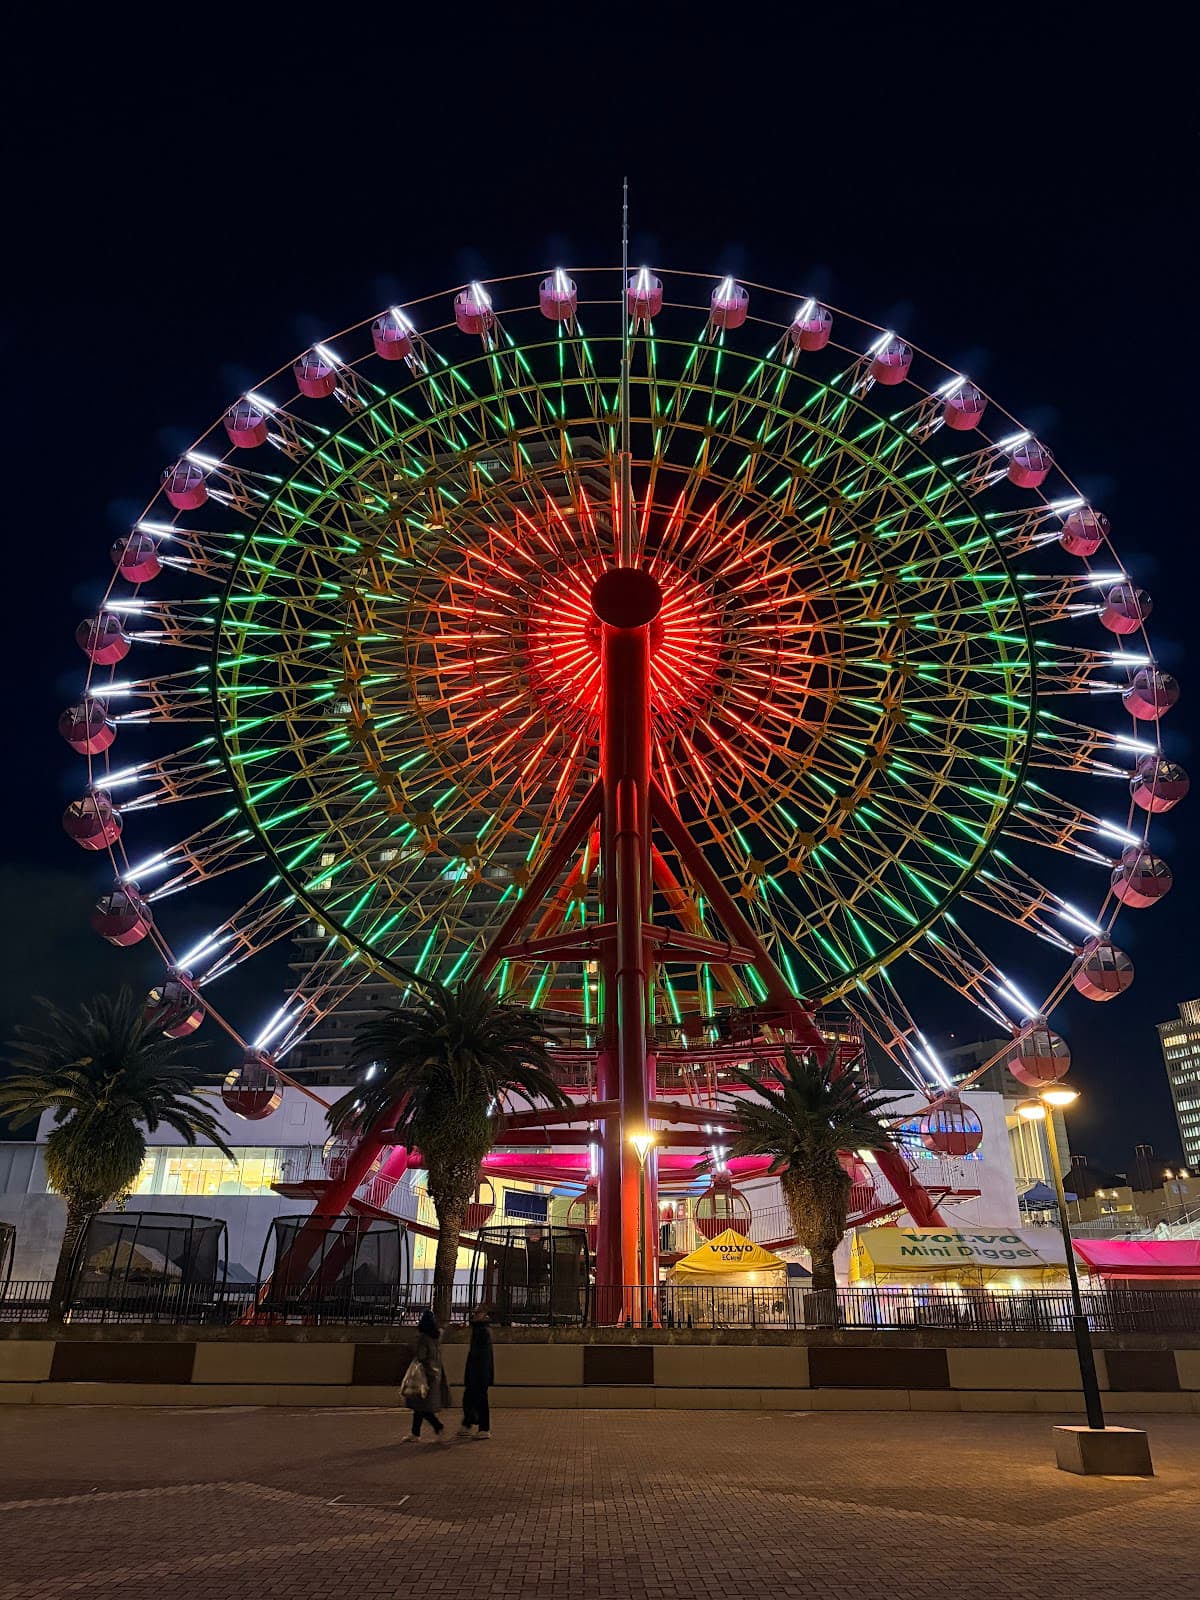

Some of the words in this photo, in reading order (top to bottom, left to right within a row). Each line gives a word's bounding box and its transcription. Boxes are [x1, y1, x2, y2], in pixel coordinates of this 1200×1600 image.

[901, 1234, 1022, 1244] VOLVO
[901, 1246, 950, 1257] Mini
[960, 1246, 1039, 1260] Digger
